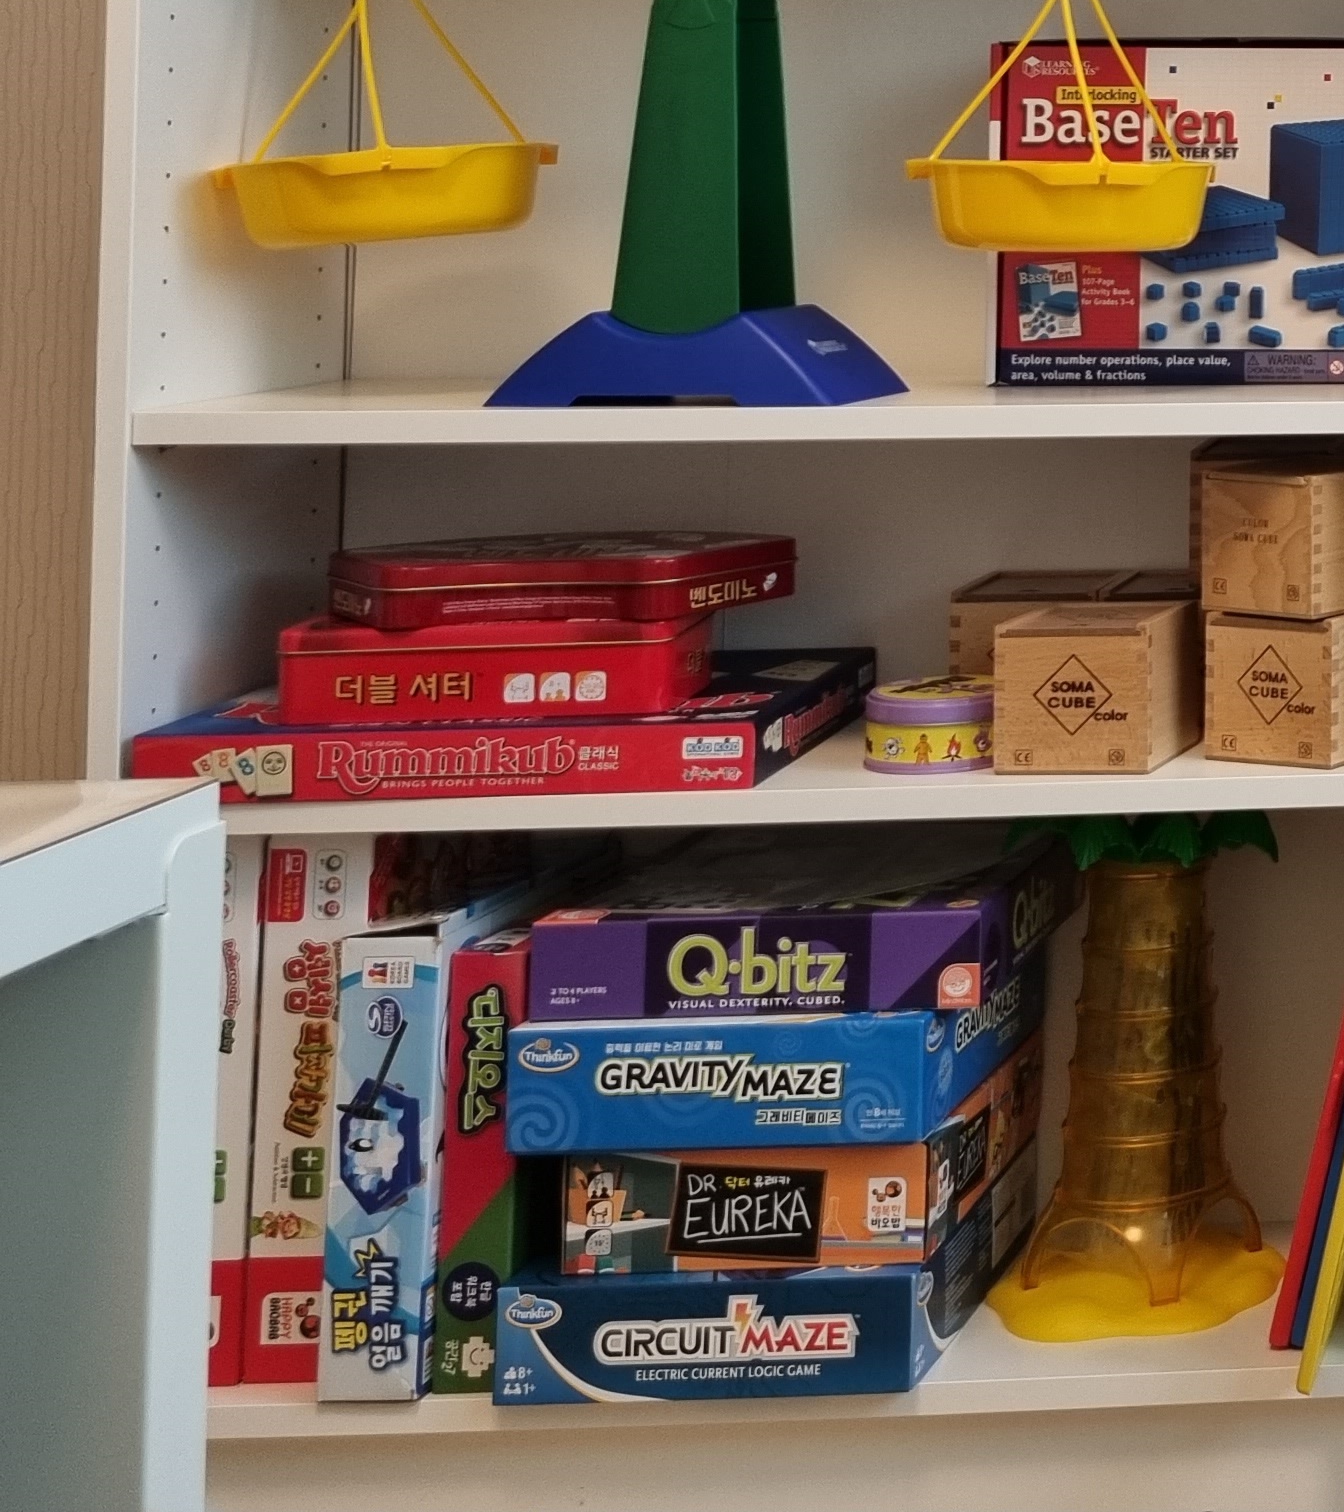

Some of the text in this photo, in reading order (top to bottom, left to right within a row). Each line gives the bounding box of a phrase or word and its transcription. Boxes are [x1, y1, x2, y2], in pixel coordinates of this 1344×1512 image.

[1214, 147, 1239, 159] SET
[1011, 354, 1230, 368] Explore number operations, place value,
[1011, 369, 1146, 382] area, volume & fractions
[1251, 669, 1288, 685] SOMA
[336, 671, 472, 704] 더블 셔터
[1051, 680, 1095, 694] SOMA
[1248, 684, 1289, 700] CUBE
[1047, 695, 1096, 710] CUBE
[1286, 701, 1315, 715] color
[1094, 707, 1128, 723] color
[578, 745, 619, 761] 클래식
[318, 735, 576, 794] Rummikub
[578, 761, 619, 771] CLASSIC
[382, 777, 545, 789] BRINGS PEOPLE TOGETHER
[668, 999, 714, 1010] VISUAL
[463, 990, 504, 1131] 디지오스
[600, 1057, 843, 1098] GRAVITY MAZE
[724, 1176, 790, 1188] 닥터 유레카
[684, 1190, 812, 1239] EUREKA
[267, 1295, 281, 1340] BAOBAB
[281, 1296, 294, 1341] HAPPY
[600, 1319, 851, 1358] CIRCUIT MAZE
[635, 1363, 821, 1381] ELECTRIC CURRENT LOGIC GAME
